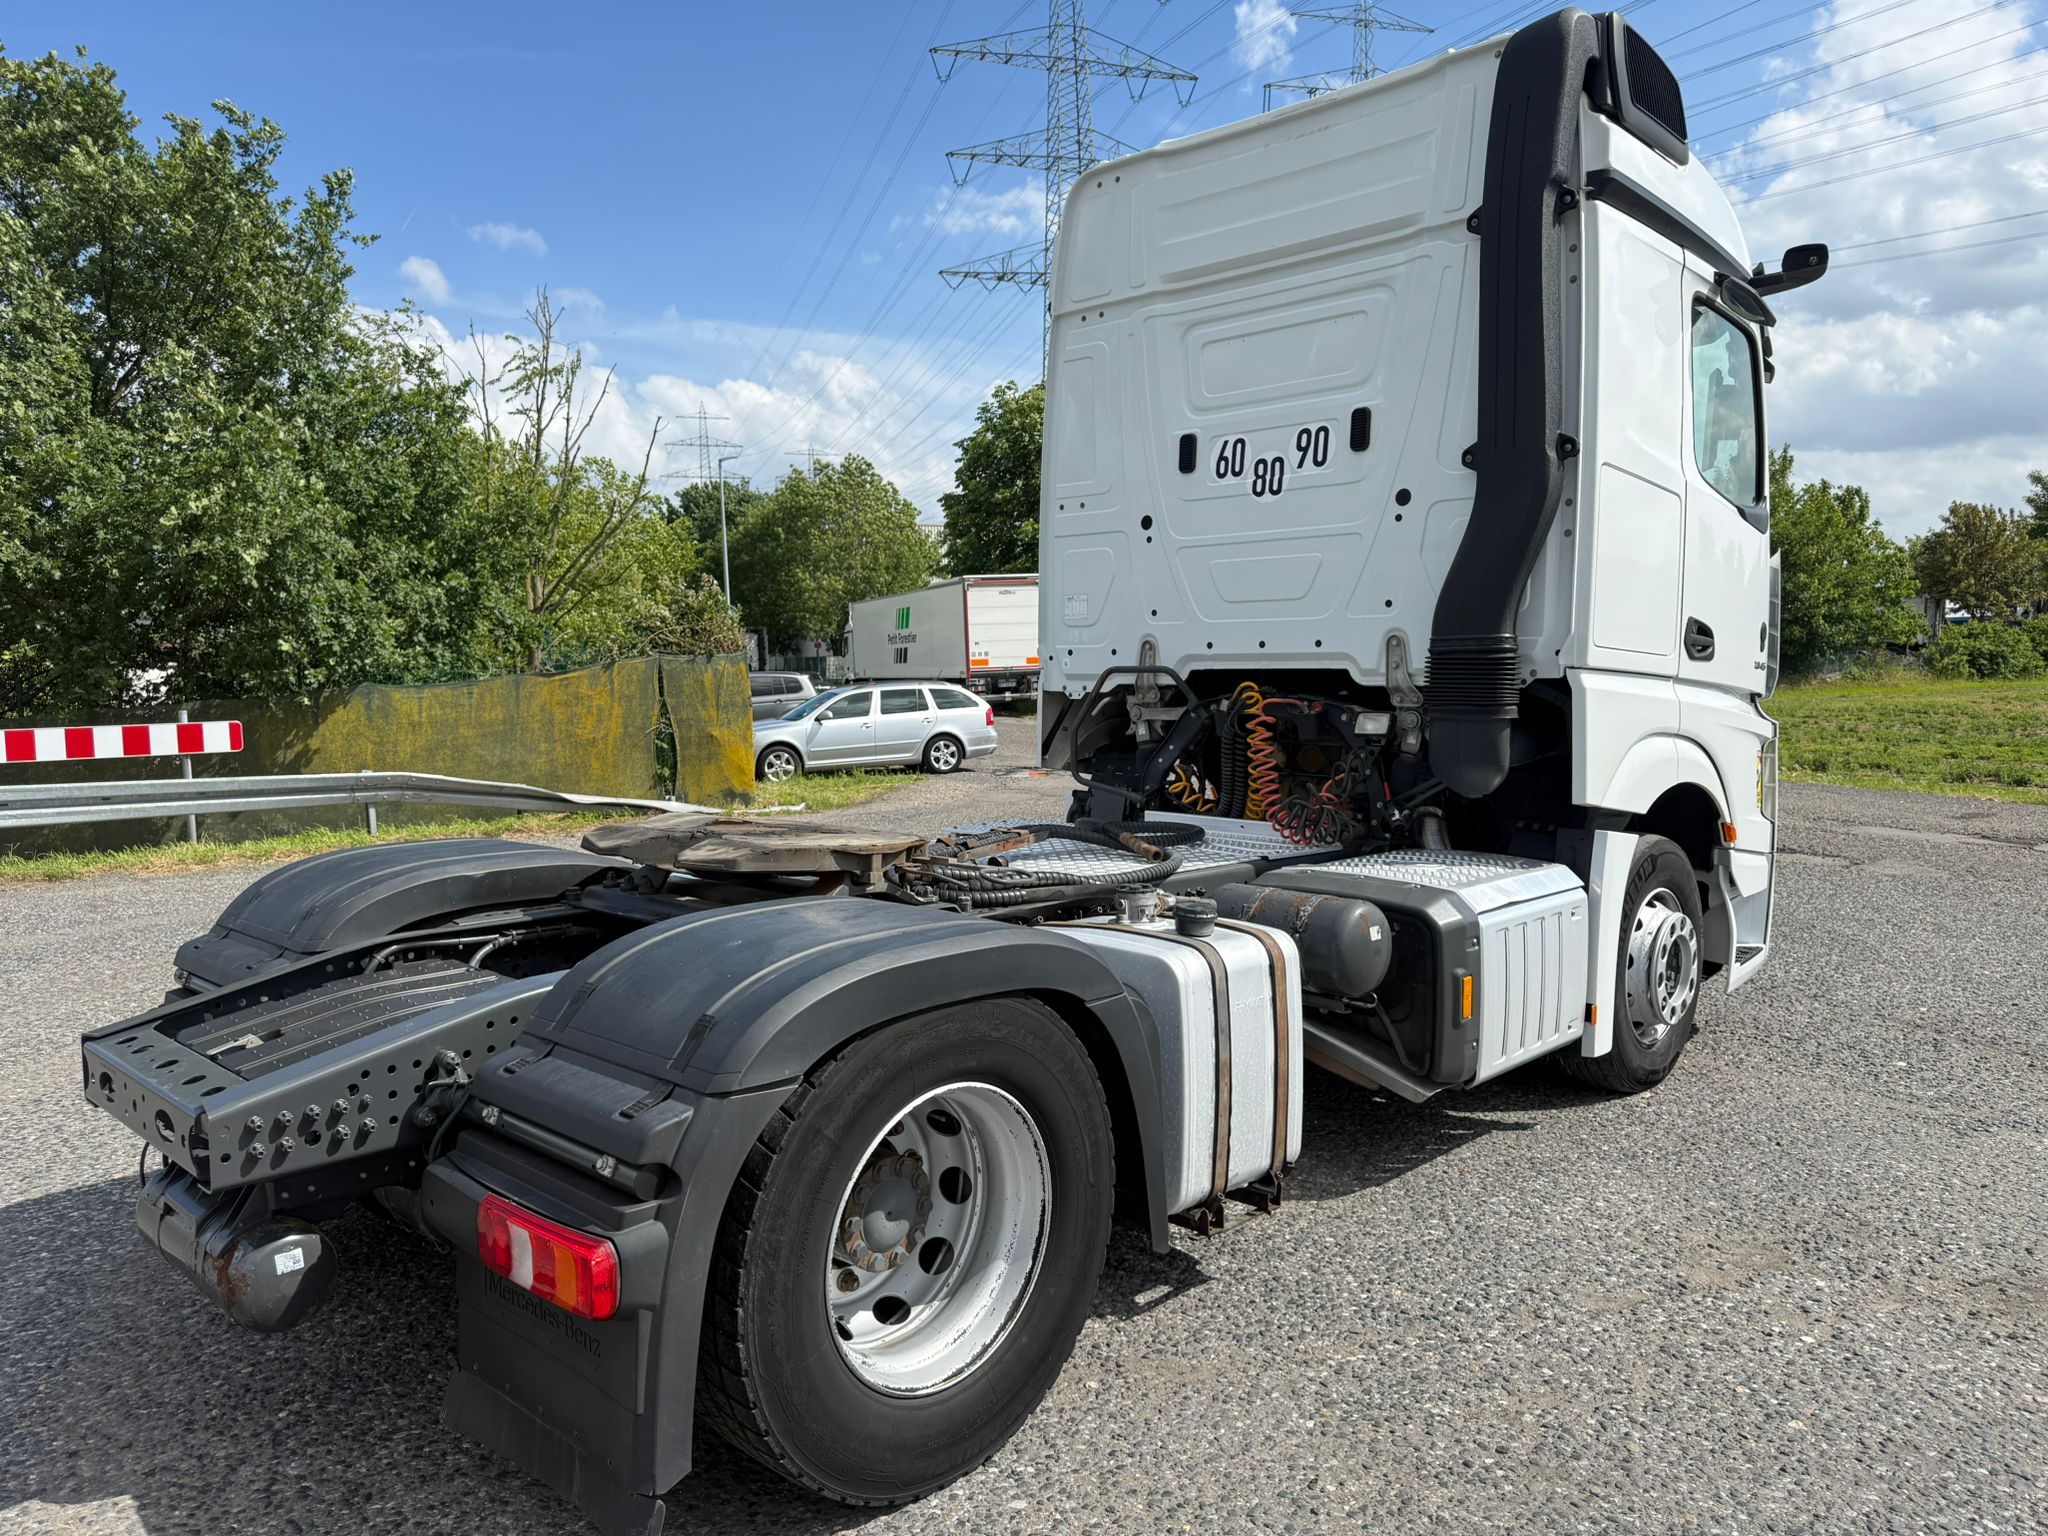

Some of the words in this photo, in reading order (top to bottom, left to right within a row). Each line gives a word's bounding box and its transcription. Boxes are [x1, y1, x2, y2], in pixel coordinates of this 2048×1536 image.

[1215, 437, 1247, 480] 60
[1295, 424, 1330, 469] 90
[1251, 456, 1285, 498] 80
[1618, 854, 1657, 950] ICHELIN
[488, 1270, 601, 1357] Mercedes-Benz
